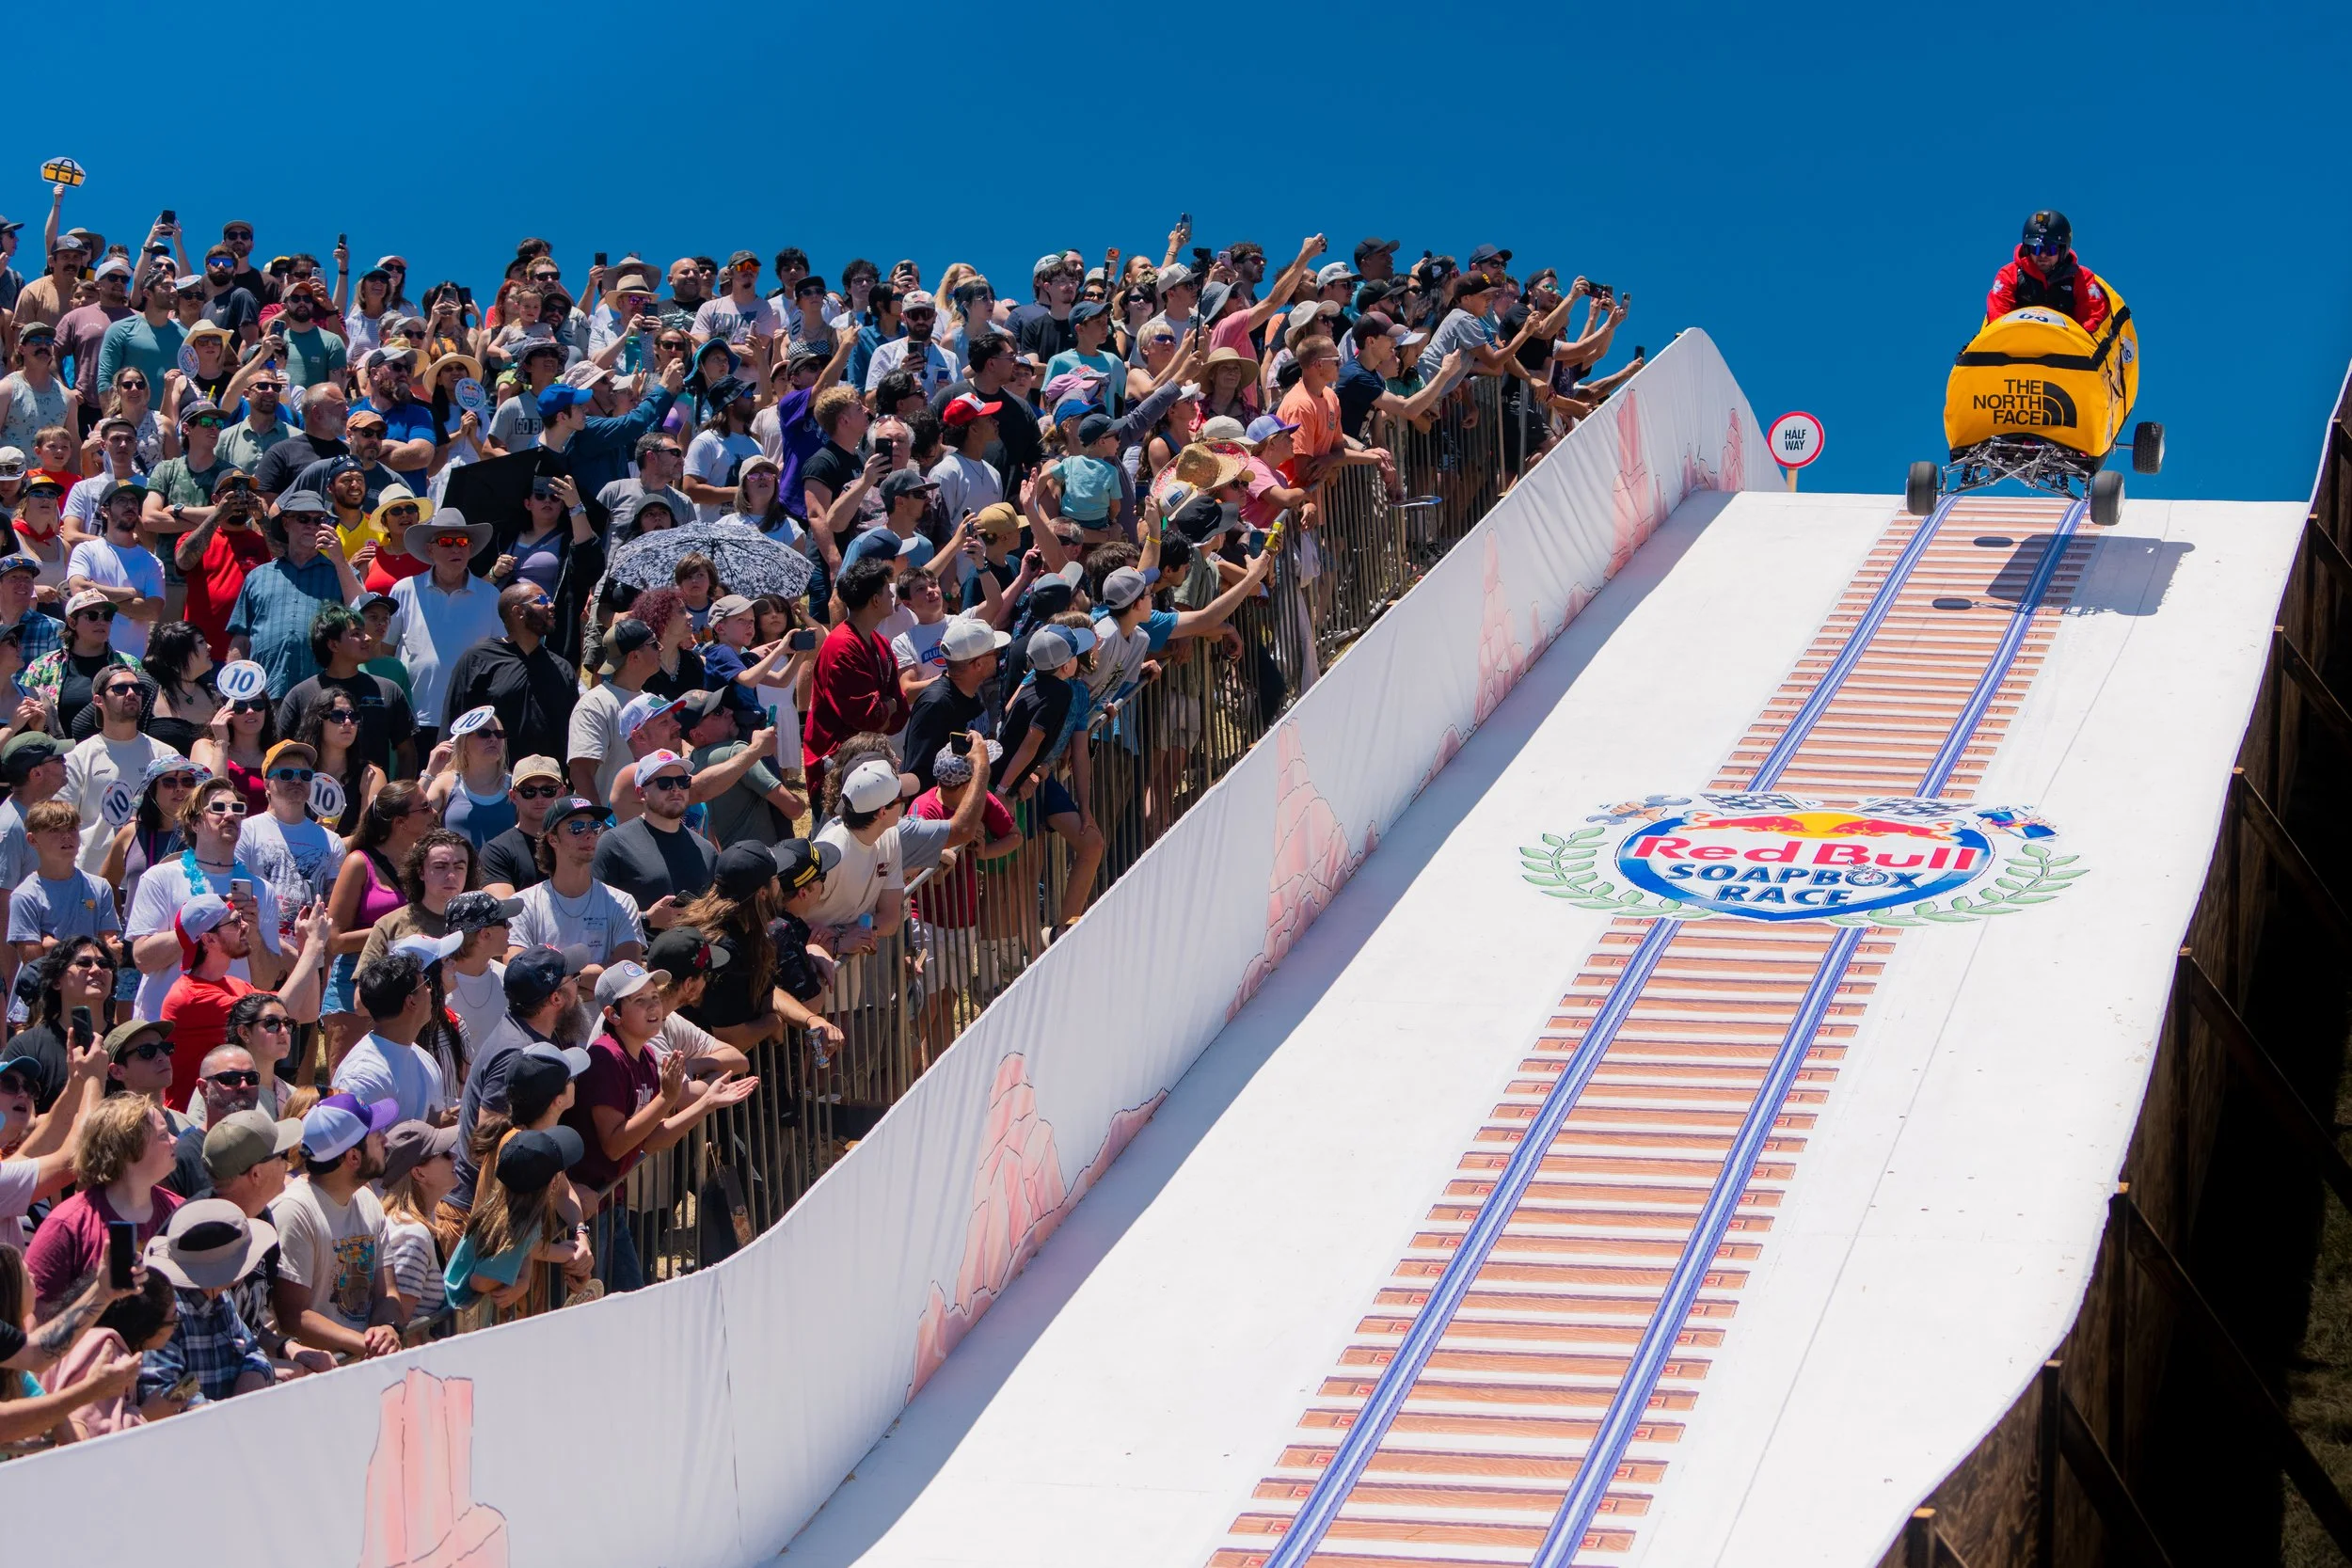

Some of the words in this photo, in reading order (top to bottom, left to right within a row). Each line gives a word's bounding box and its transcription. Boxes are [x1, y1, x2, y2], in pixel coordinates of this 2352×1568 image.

[791, 315, 802, 336] 10
[2004, 379, 2042, 395] THE
[1973, 395, 2042, 410] NORTH
[1994, 409, 2042, 426] FACE
[516, 419, 529, 435] GO
[1785, 429, 1806, 439] HALF
[1785, 440, 1805, 451] WAY
[924, 646, 942, 660] BLU
[228, 667, 255, 693] 10
[459, 711, 485, 729] 10
[105, 789, 130, 820] 10
[314, 780, 336, 812] 10
[1633, 835, 1804, 864] Red
[1812, 843, 1975, 870] Bull
[1711, 884, 1854, 907] RACE
